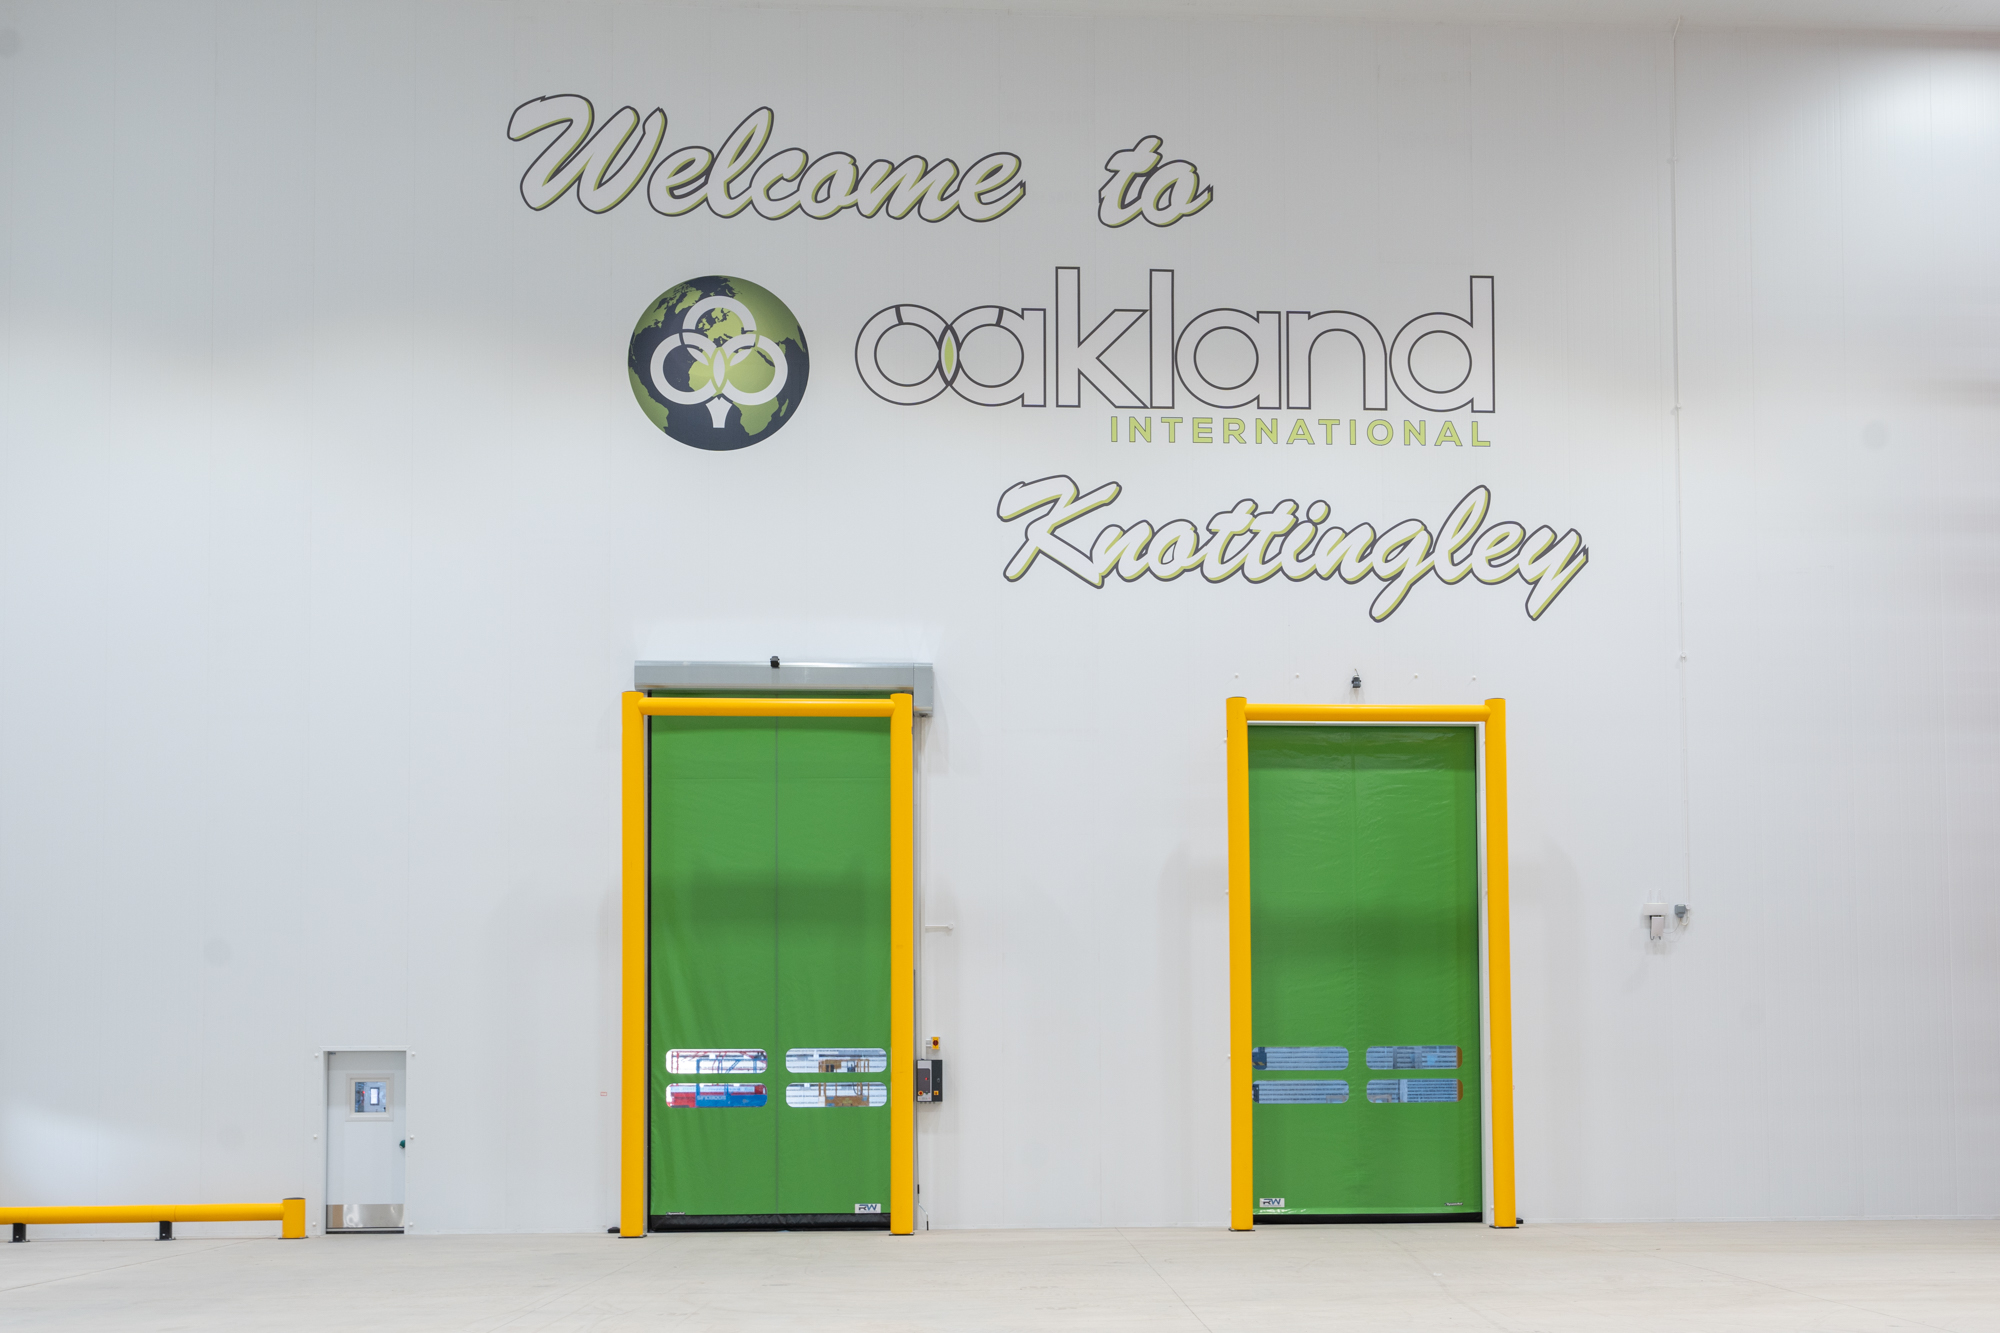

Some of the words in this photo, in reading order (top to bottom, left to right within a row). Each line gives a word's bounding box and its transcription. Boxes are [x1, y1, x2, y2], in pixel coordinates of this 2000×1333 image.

[507, 94, 1026, 223] Welcome
[1098, 135, 1214, 228] to
[855, 266, 1495, 413] oakland
[1110, 416, 1491, 447] INTERNATIONAL
[996, 474, 1589, 622] Knottingley
